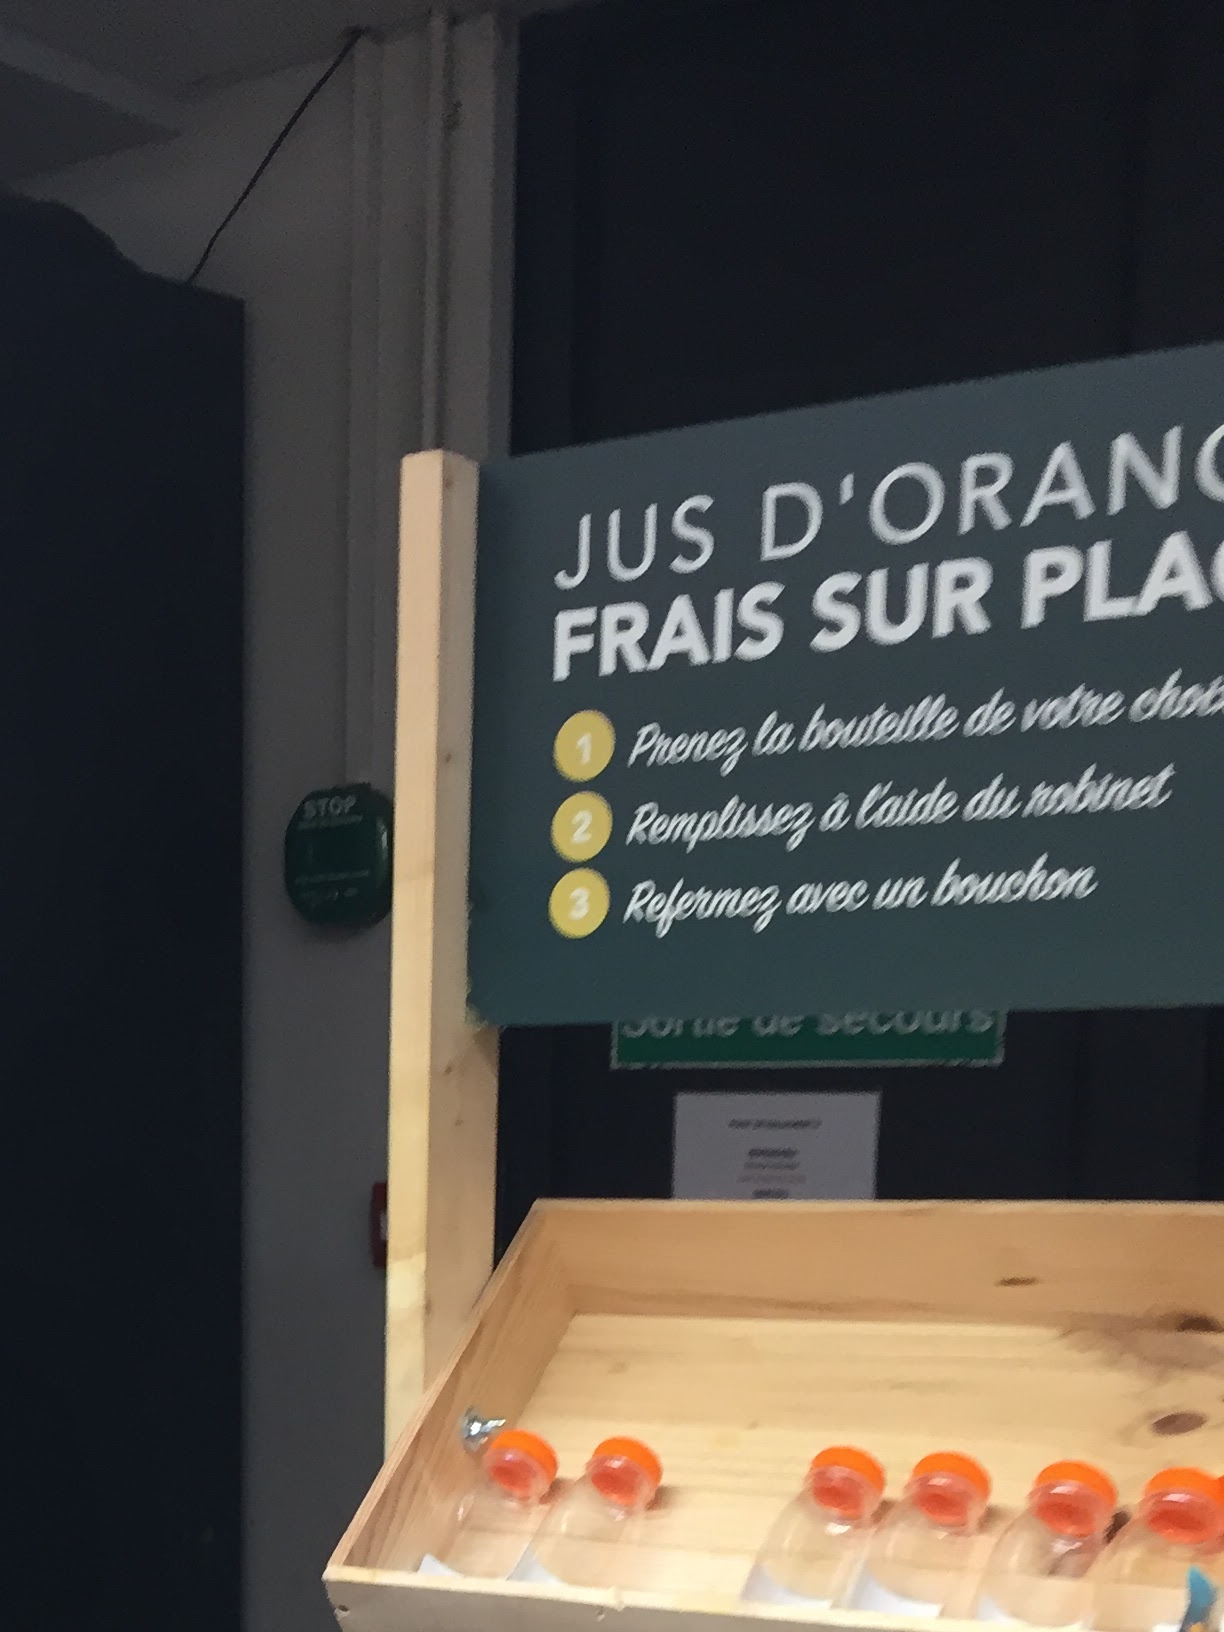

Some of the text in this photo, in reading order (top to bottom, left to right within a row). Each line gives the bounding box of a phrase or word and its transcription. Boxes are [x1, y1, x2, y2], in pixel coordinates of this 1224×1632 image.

[554, 495, 715, 590] JUS
[553, 530, 1224, 683] FRAIS SUR PLA
[576, 732, 592, 765] 1
[627, 721, 749, 778] Prenez
[752, 710, 796, 756] la
[798, 693, 960, 752] bouteille
[962, 687, 1016, 738] de
[1020, 682, 1126, 733] votre
[570, 762, 1176, 853] 2 Remplissez à l'aide du robinet
[569, 852, 1099, 939] 3 Refermez avec un bouchon
